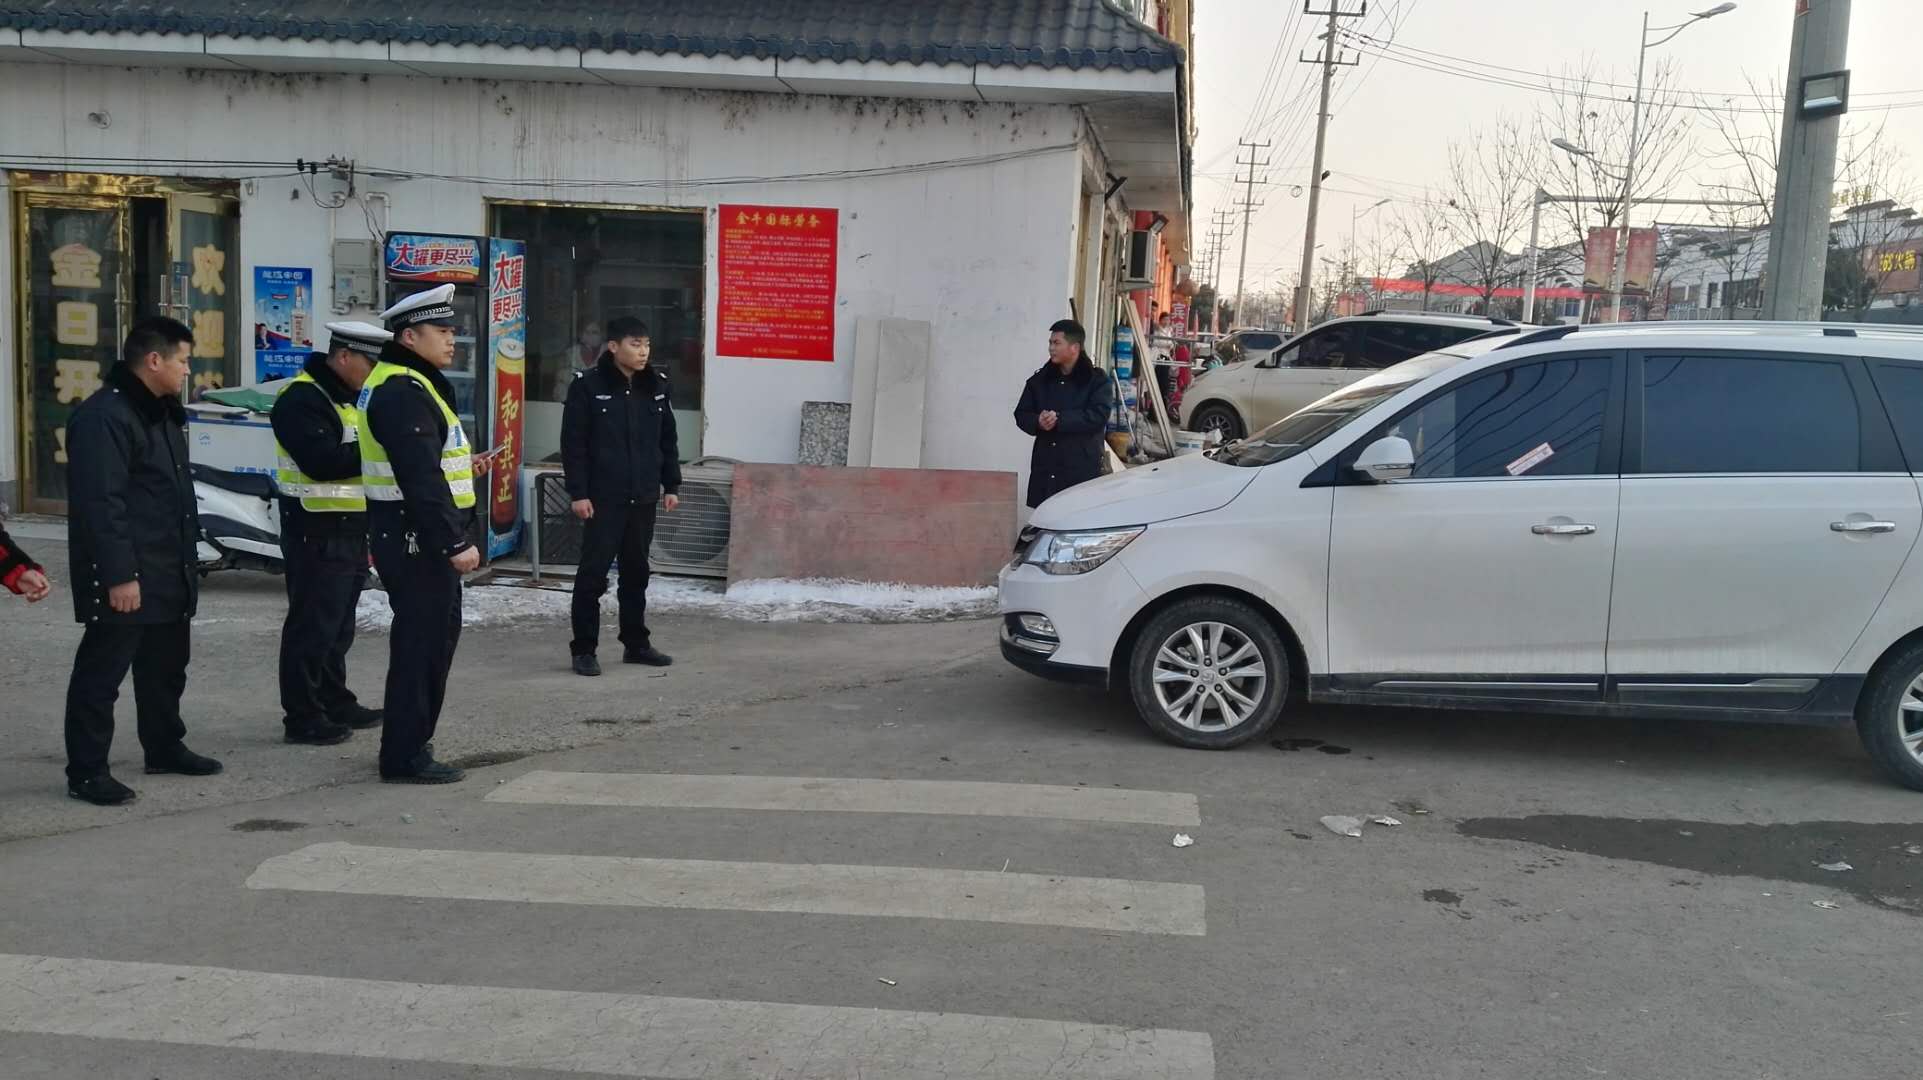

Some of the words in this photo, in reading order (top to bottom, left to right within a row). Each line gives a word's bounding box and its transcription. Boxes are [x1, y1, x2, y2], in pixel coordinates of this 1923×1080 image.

[392, 242, 474, 268] 大罐更尽兴
[494, 253, 523, 293] 大罐
[492, 294, 522, 323] 更尽兴
[497, 389, 519, 503] 和其正
